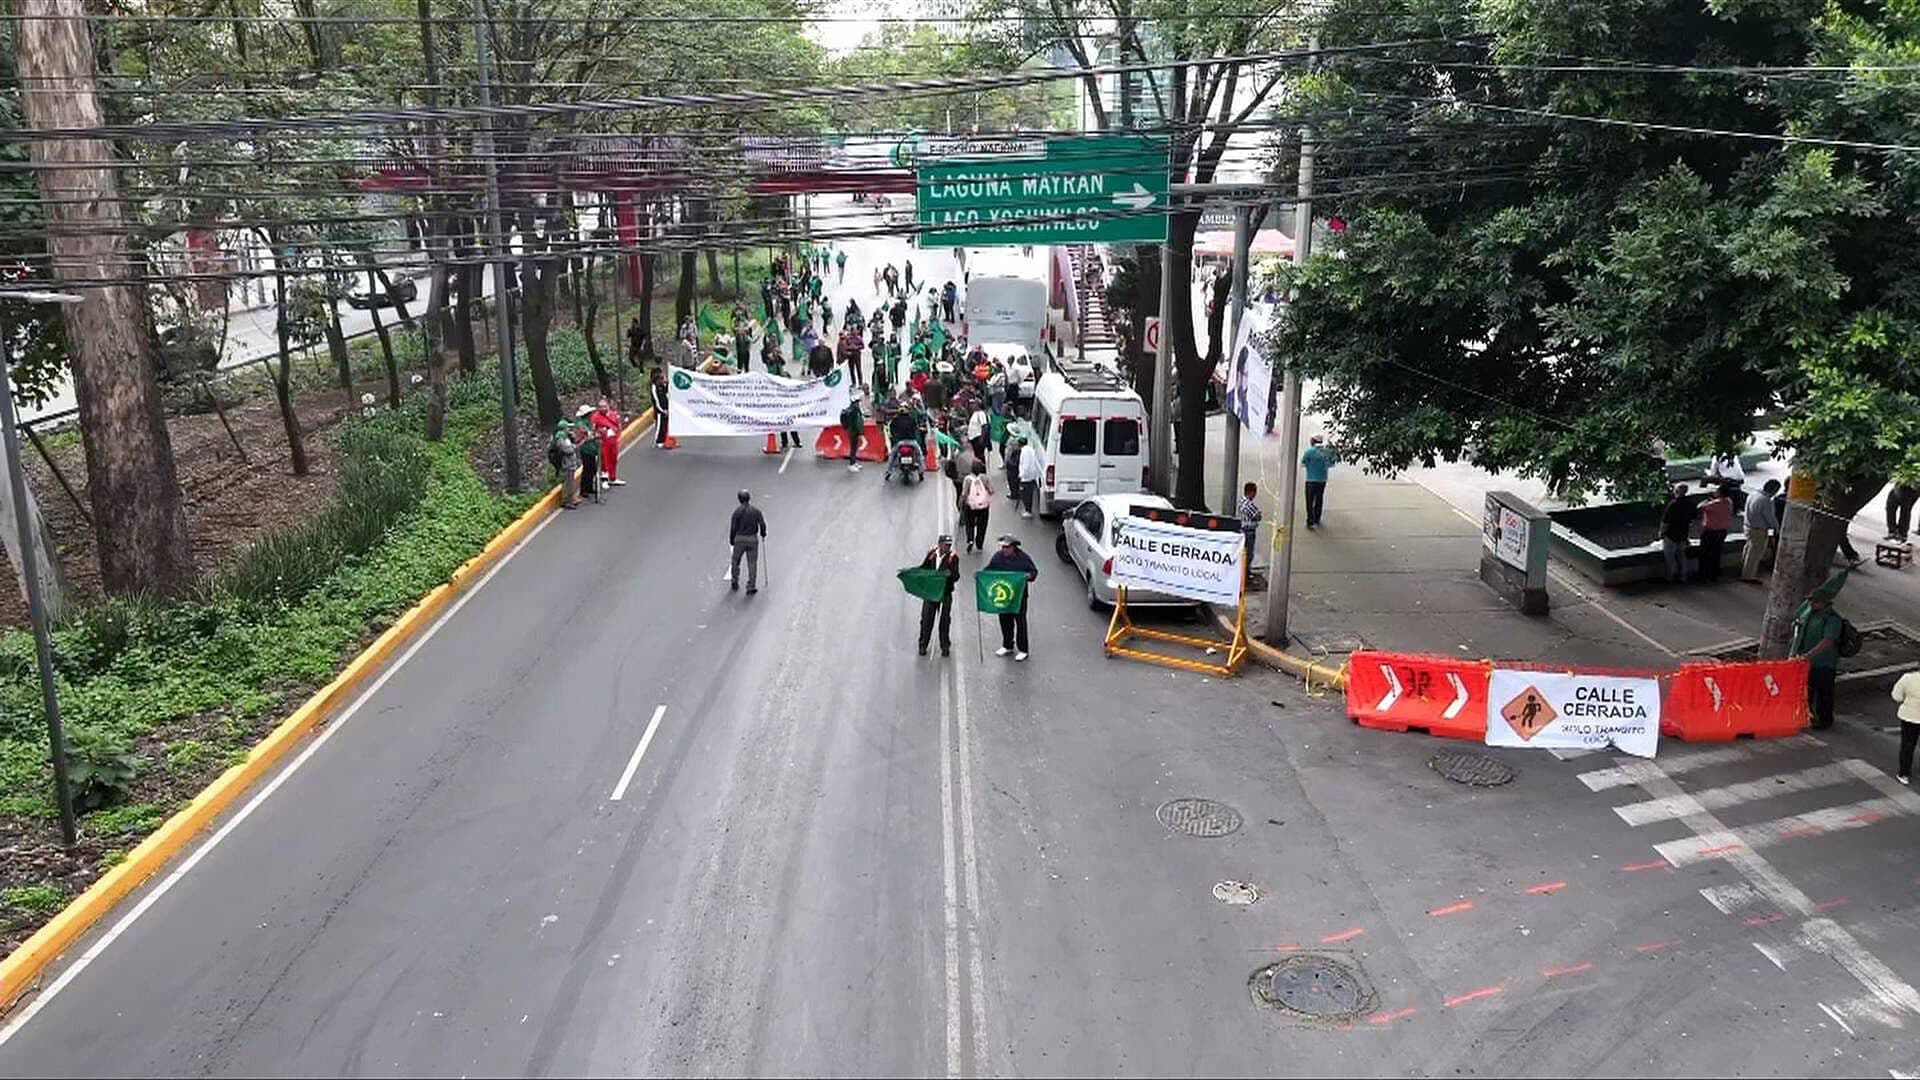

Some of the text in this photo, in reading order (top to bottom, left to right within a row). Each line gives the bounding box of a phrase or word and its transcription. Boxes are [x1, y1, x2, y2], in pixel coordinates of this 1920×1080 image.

[930, 171, 1104, 198] LAGUNA MAYRAN
[930, 206, 1101, 234] LAGO XOCHIMILCO
[1116, 534, 1233, 567] CALLE CERRADA
[1191, 569, 1222, 582] LOCAL
[1575, 686, 1634, 704] CALLE
[1563, 702, 1647, 719] CERRADA
